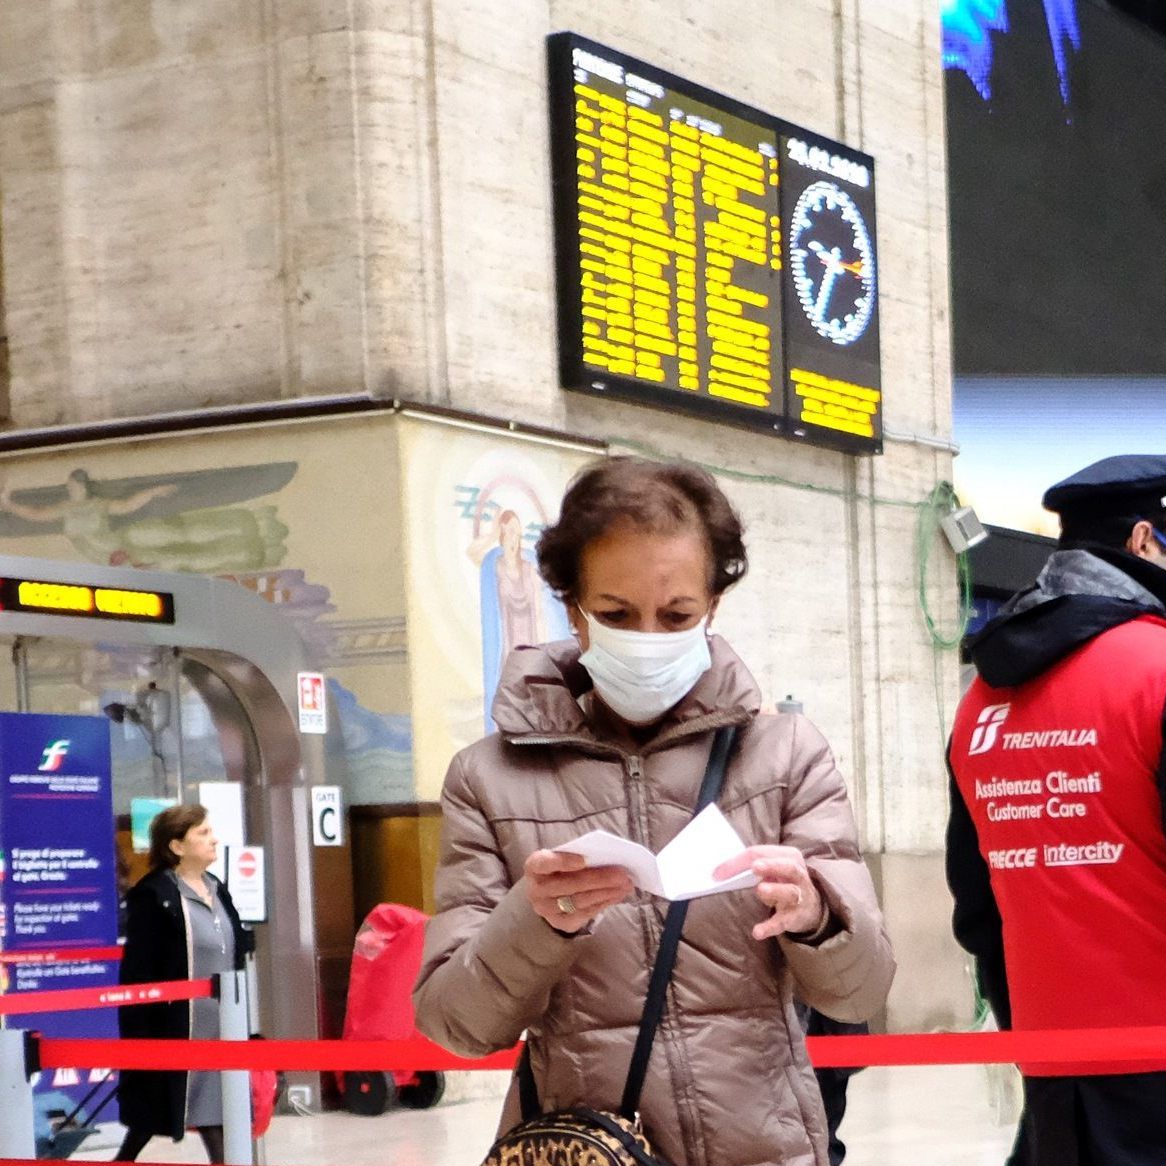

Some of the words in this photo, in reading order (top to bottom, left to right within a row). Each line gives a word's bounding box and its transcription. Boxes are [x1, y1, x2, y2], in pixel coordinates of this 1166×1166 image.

[1002, 729, 1098, 750] TRENITALIA
[975, 776, 1042, 799] Assistenza
[1046, 771, 1102, 793] Clienti
[987, 801, 1044, 821] Customer
[1046, 797, 1087, 818] Care
[320, 807, 336, 842] C
